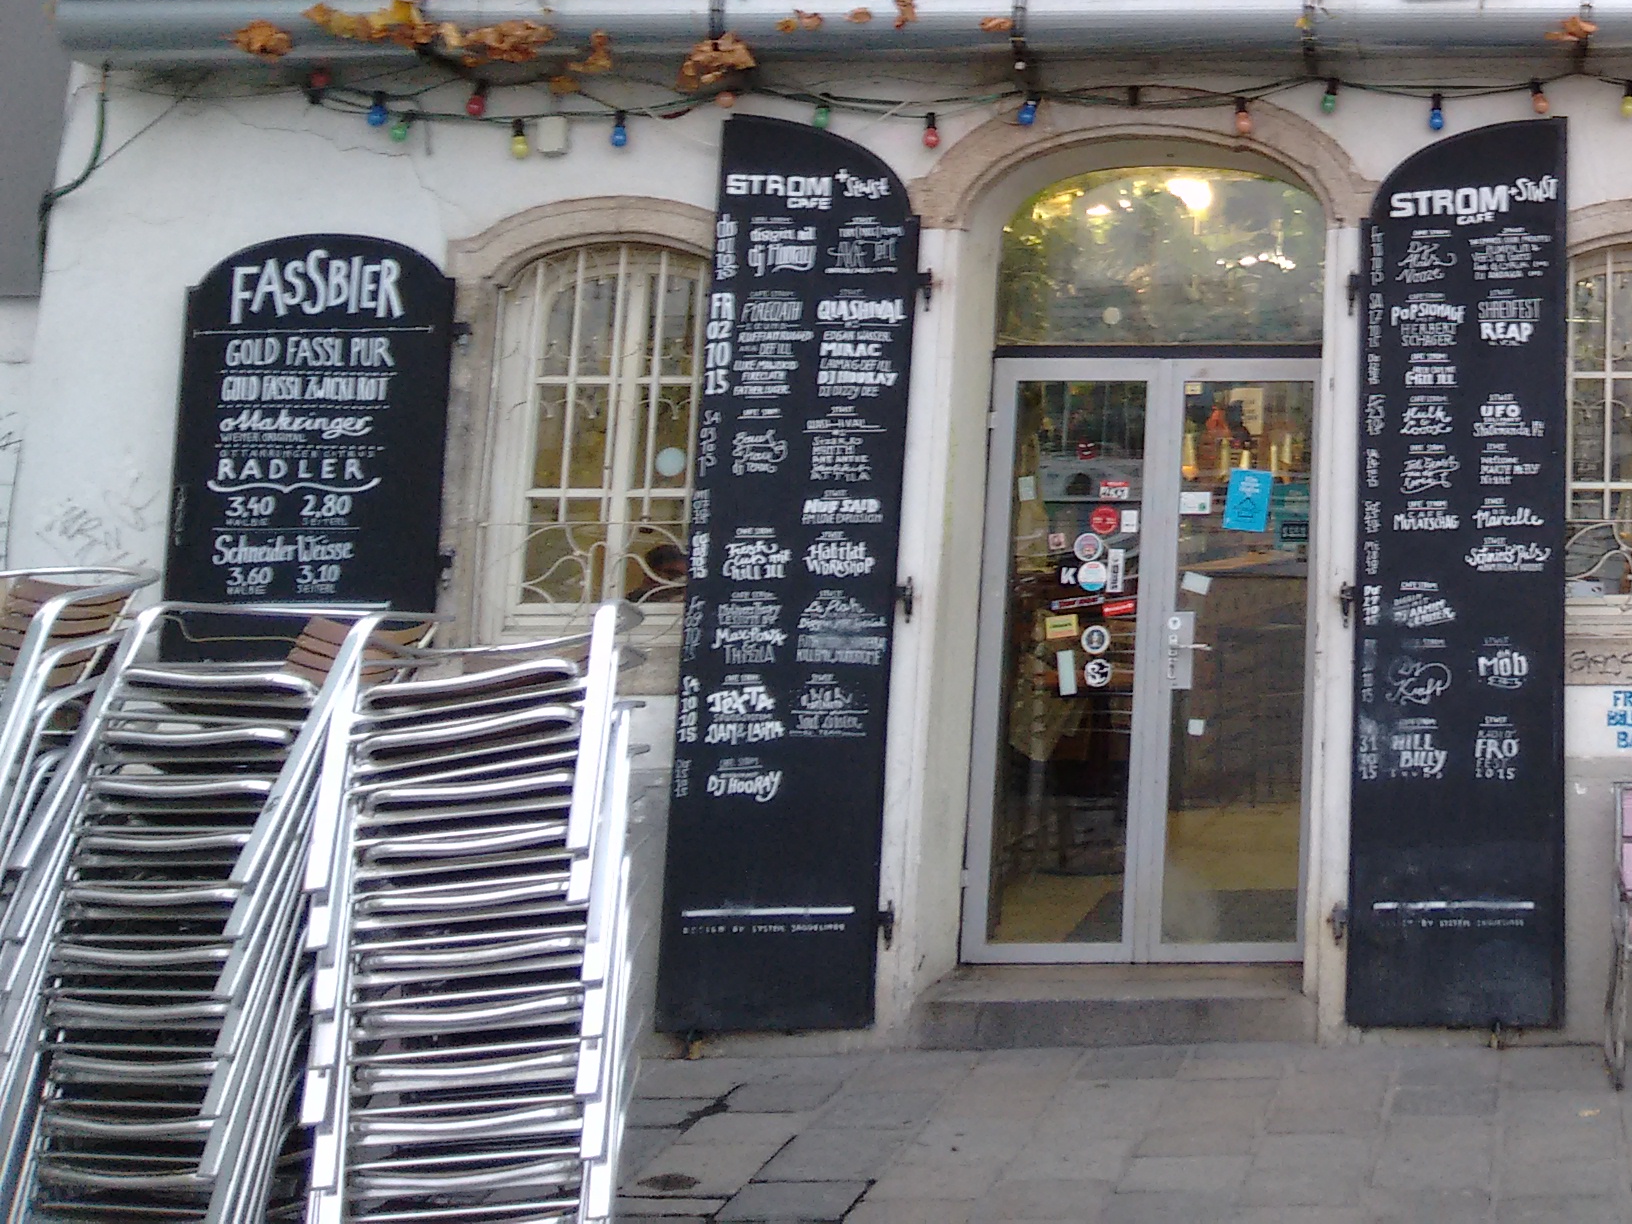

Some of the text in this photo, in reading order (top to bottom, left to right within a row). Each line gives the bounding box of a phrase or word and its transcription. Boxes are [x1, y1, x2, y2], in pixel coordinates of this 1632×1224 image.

[726, 173, 833, 197] STROM
[786, 197, 833, 210] CAFE
[1389, 184, 1511, 218] STROM
[1456, 211, 1496, 226] CAFE
[230, 249, 405, 325] FASSBIER
[710, 292, 736, 321] FR
[1477, 298, 1544, 320] SHREDFEST
[706, 321, 733, 340] 02
[1479, 322, 1535, 343] REAP
[225, 336, 394, 367] GOLD FASSL PUR
[704, 341, 733, 369] 10
[819, 342, 883, 357] MIRAC
[221, 376, 261, 401] GOLD
[261, 376, 303, 401] FASSL
[704, 368, 730, 395] 15
[1480, 404, 1522, 418] UFO
[217, 458, 366, 481] RADLER
[1472, 507, 1545, 529] Marcelle
[212, 534, 355, 566] Schneider Weisse
[802, 556, 877, 578] WORKSHOP
[677, 727, 698, 743] 15
[1475, 738, 1521, 760] FRO
[1359, 765, 1379, 780] 15
[1401, 750, 1448, 775] BILLY
[1475, 768, 1517, 780] 2015
[706, 774, 727, 797] DJ
[727, 770, 783, 803] HOORAY
